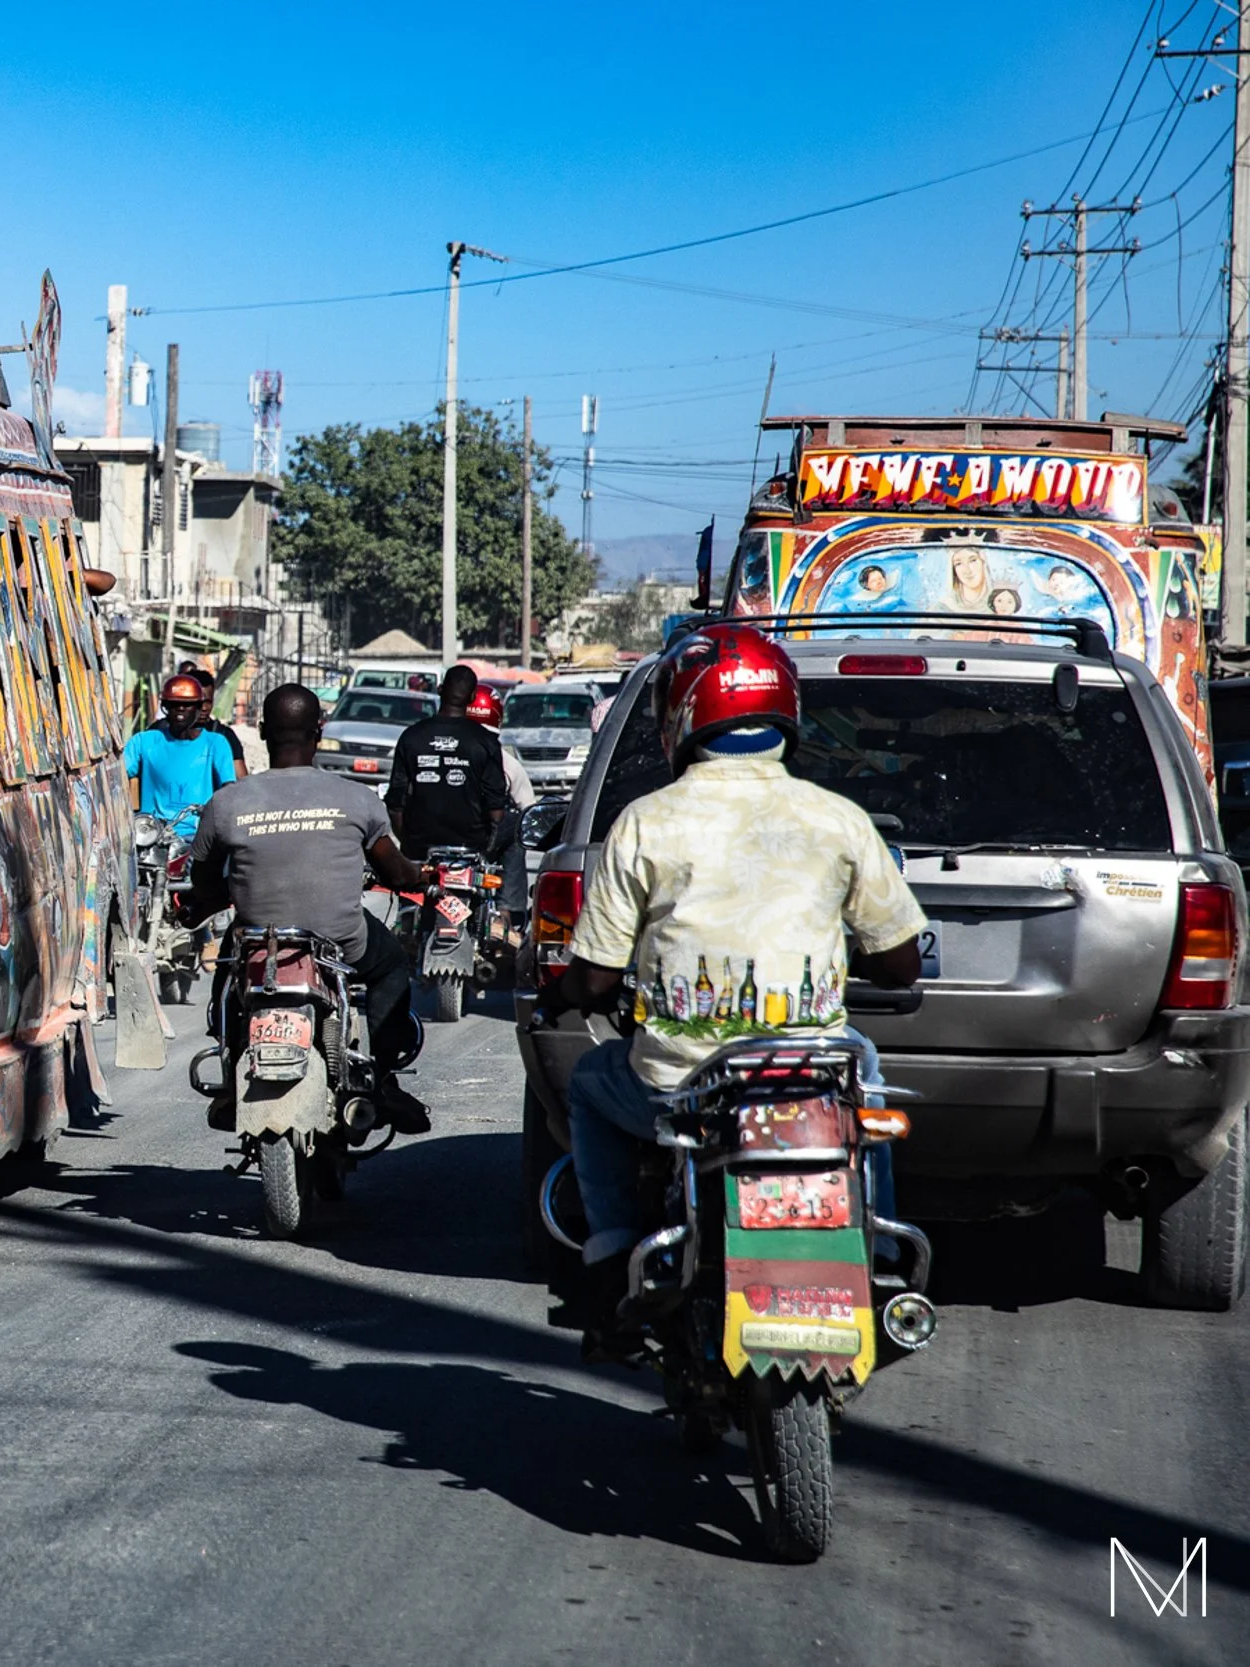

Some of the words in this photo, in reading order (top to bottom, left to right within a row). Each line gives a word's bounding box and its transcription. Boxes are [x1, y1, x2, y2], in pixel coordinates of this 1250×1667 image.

[236, 815, 255, 826] THIS
[255, 812, 265, 823] IS
[265, 810, 284, 821] NOT
[283, 810, 291, 819] A
[291, 808, 347, 819] COMEBACK...
[248, 825, 266, 836] THIS
[267, 823, 278, 833] IS
[278, 822, 300, 832] WHO
[301, 820, 315, 831] WE
[316, 820, 335, 830] ARE.
